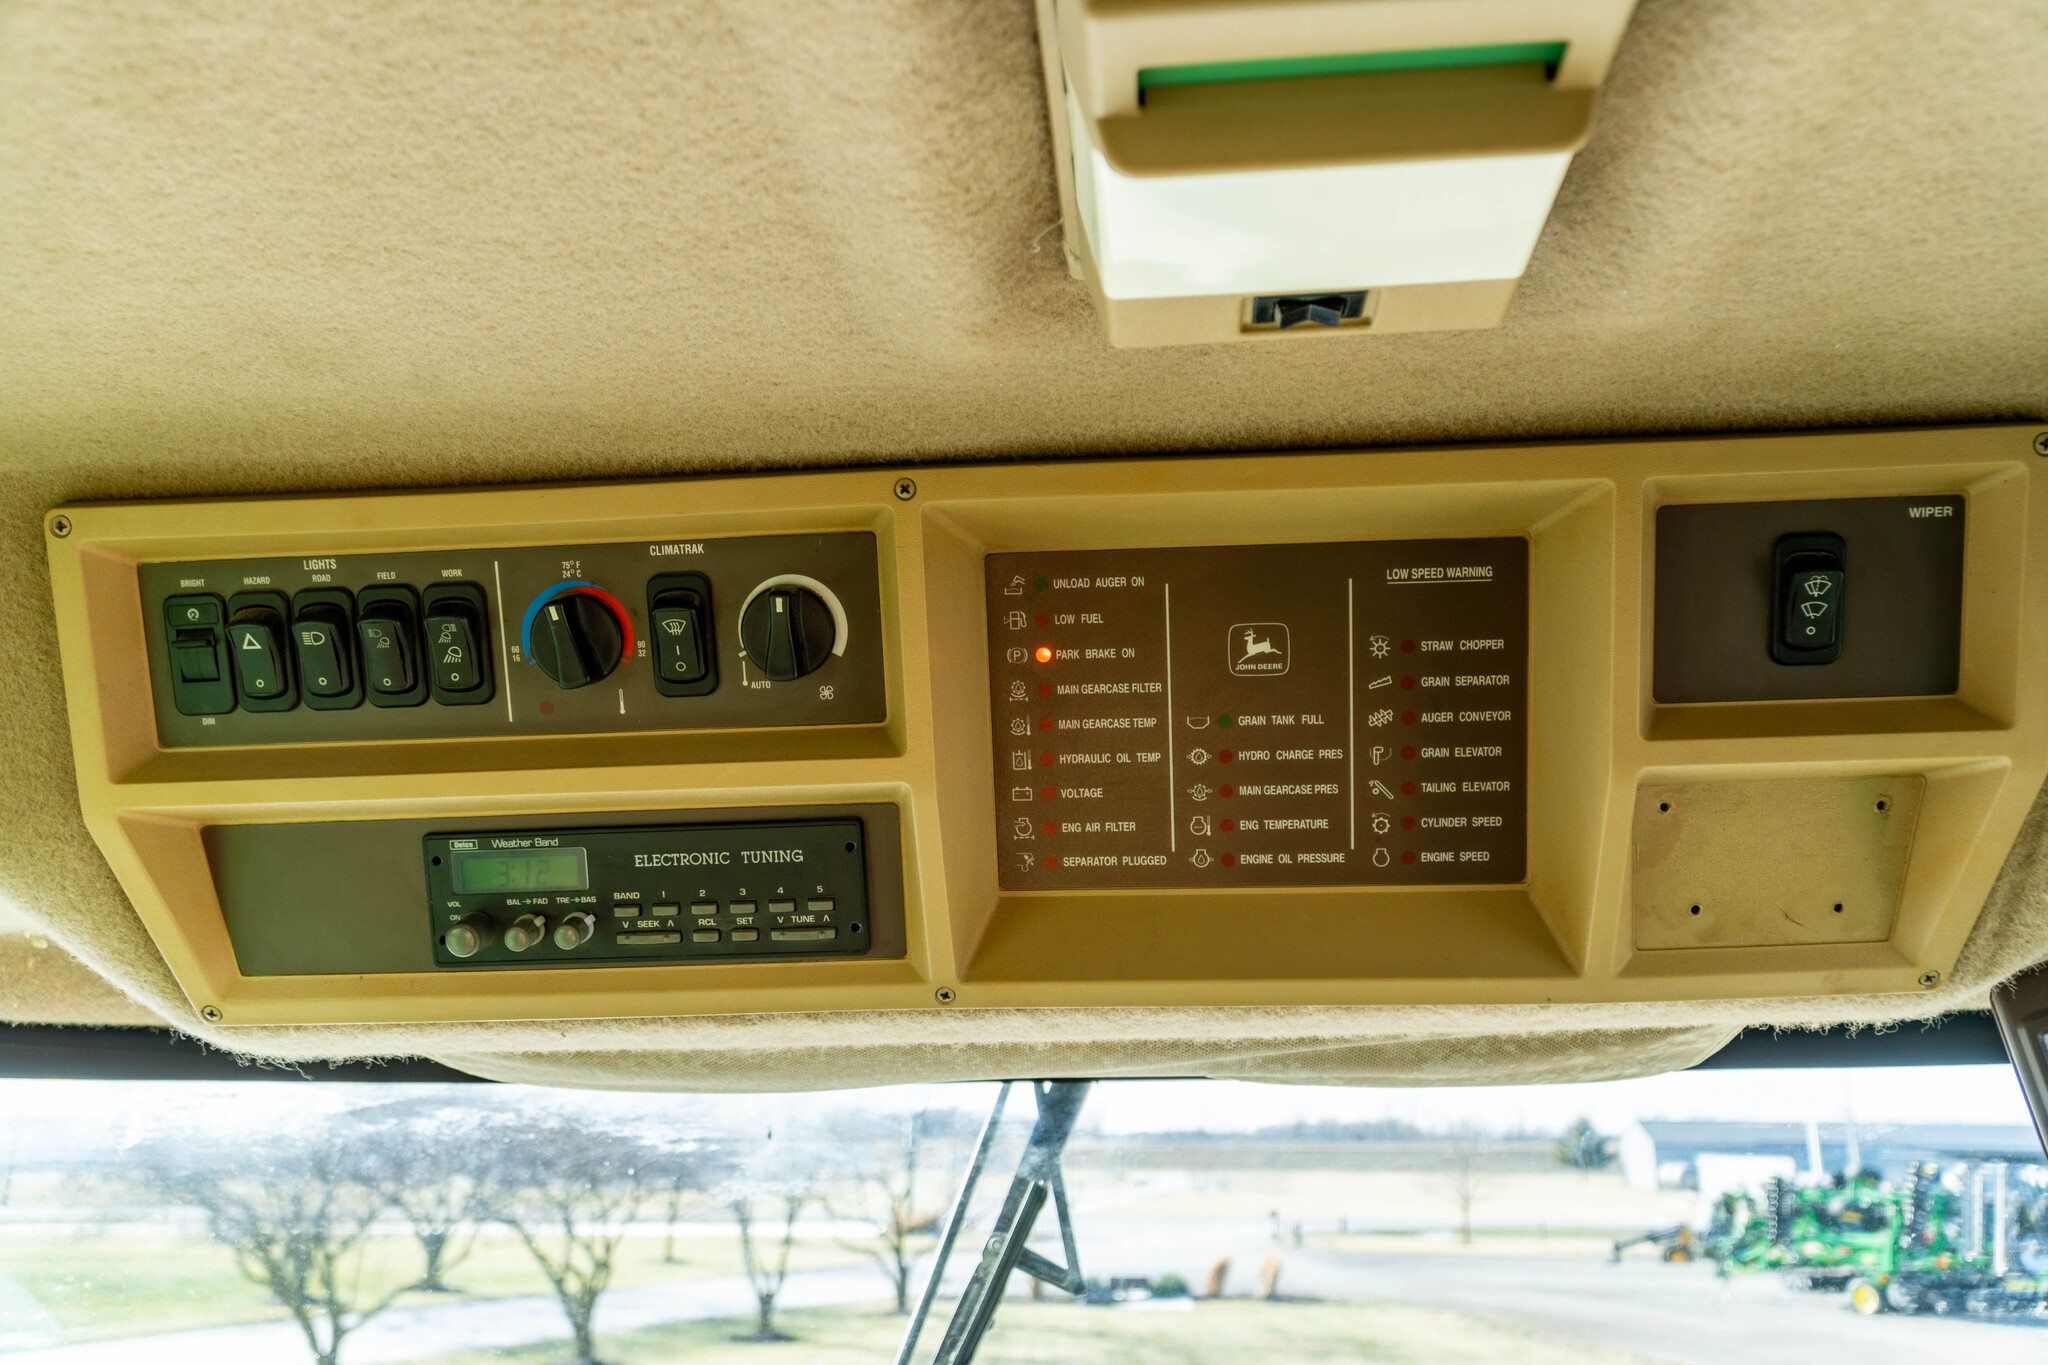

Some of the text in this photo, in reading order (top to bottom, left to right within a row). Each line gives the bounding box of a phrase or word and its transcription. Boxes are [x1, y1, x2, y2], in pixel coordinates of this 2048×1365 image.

[1909, 506, 1953, 518] WIPER
[650, 544, 704, 556] CLIMATRAK
[303, 559, 337, 570] LIGHTS
[576, 560, 581, 568] F
[312, 574, 331, 582] ROAD
[377, 572, 396, 580] FIELD
[442, 569, 462, 577] WORK
[577, 569, 582, 577] C
[1387, 566, 1493, 580] LOW SPEED WARNING
[180, 579, 205, 588] BRIGHT
[243, 576, 271, 585] HAZARD
[1053, 577, 1145, 589] UNLOAD AUGER ON
[1055, 614, 1104, 624] LOW FUEL
[1421, 639, 1504, 651] STRAW CHOPPER
[638, 649, 646, 657] 32
[1056, 649, 1135, 659] PARK BRAKE ON
[751, 681, 771, 689] AUTO
[1421, 675, 1510, 687] GRAIN SEPARATOR
[1057, 683, 1162, 694] MAIN GEARCASE FILTER
[1238, 715, 1324, 726] GRAIN TANK FULL
[1421, 711, 1511, 722] AUGER CONVEYOR
[1058, 718, 1157, 729] MAIN GEARCASE TEMP
[1239, 749, 1343, 761] HYDRO CHARGE PRES
[1421, 746, 1502, 758] GRAIN ELEVATOR
[1060, 753, 1161, 764] HYDRAULIC OIL TEMP
[1240, 784, 1338, 795] MAIN GEARCASE PRES
[1421, 781, 1510, 793] TAILING ELEVATOR
[1061, 788, 1103, 798] VOLTAGE
[1062, 822, 1136, 833] ENG AIR FILTER
[1240, 819, 1329, 830] ENG TEMPERATURE
[1421, 816, 1502, 828] CYLINDER SPEED
[491, 837, 558, 848] Weather Band
[634, 850, 803, 867] ELECTRONIC TUNING
[1063, 856, 1167, 867] SEPARATOR PLUGGED
[1241, 854, 1345, 864] ENGINE OIL PRESSURE
[1421, 851, 1490, 862] ENGINE SPEED
[739, 888, 746, 896] 3
[817, 885, 823, 893] 5
[533, 897, 548, 905] FAD
[556, 895, 596, 904] TRE BAS
[614, 892, 640, 900] BAND
[637, 920, 660, 928] SEEK
[736, 917, 754, 925] SET
[791, 915, 815, 923] TUNE
